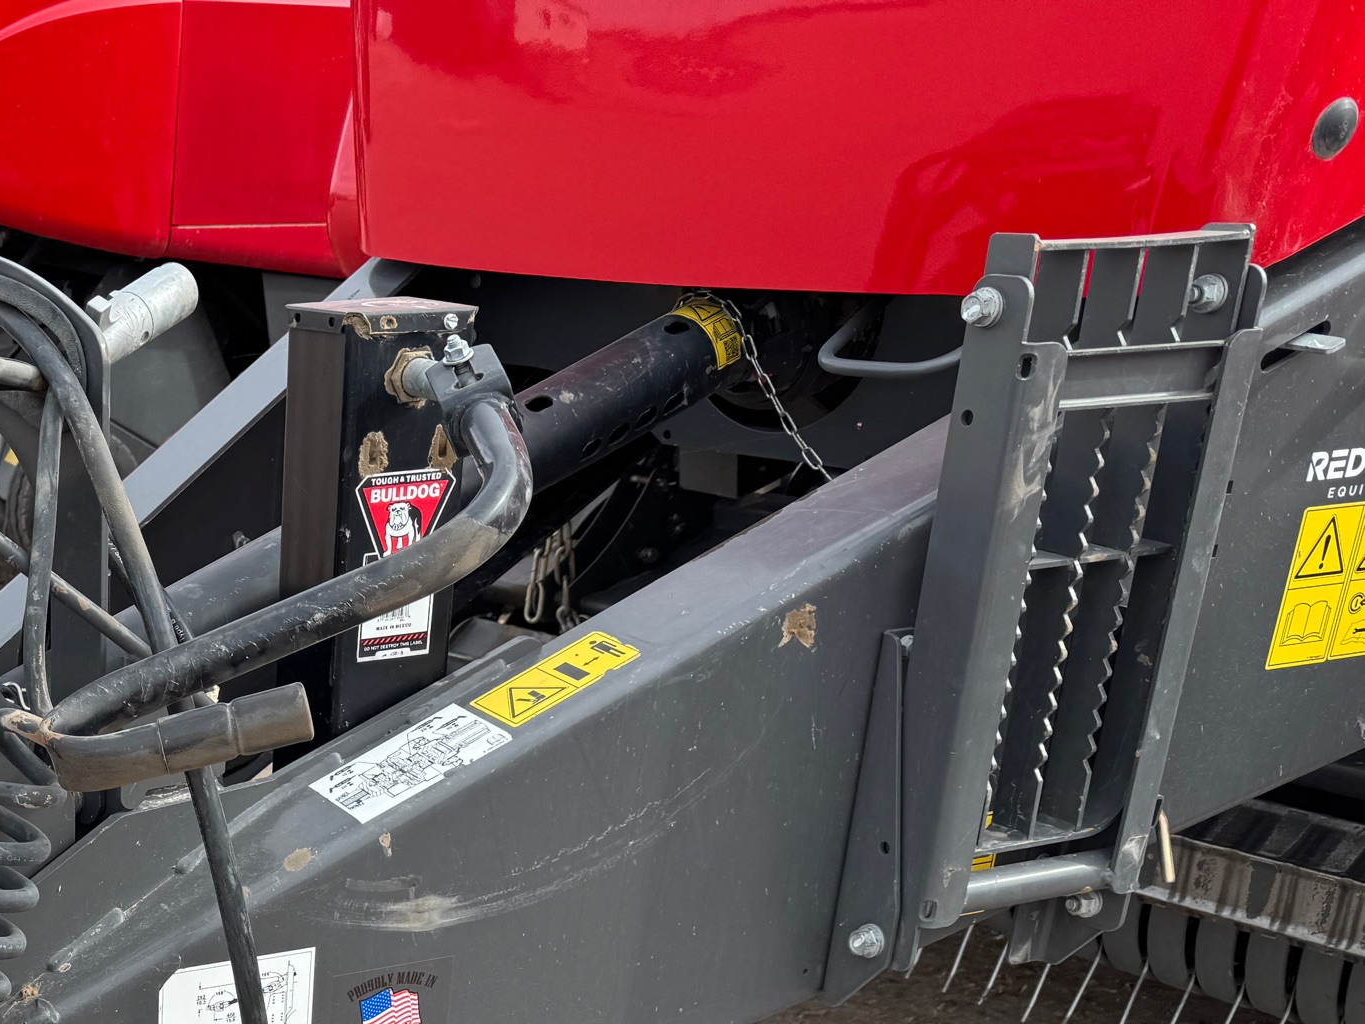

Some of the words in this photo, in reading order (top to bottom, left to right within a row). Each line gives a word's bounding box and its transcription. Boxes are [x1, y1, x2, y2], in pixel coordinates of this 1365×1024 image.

[1306, 447, 1365, 482] RED
[371, 476, 399, 486] TOUGH
[400, 475, 405, 483] &
[406, 472, 442, 482] TRUSTED
[370, 483, 440, 504] BULLDOG
[347, 973, 394, 1003] PROUDLY
[396, 971, 425, 986] MADE
[424, 973, 438, 989] IN
